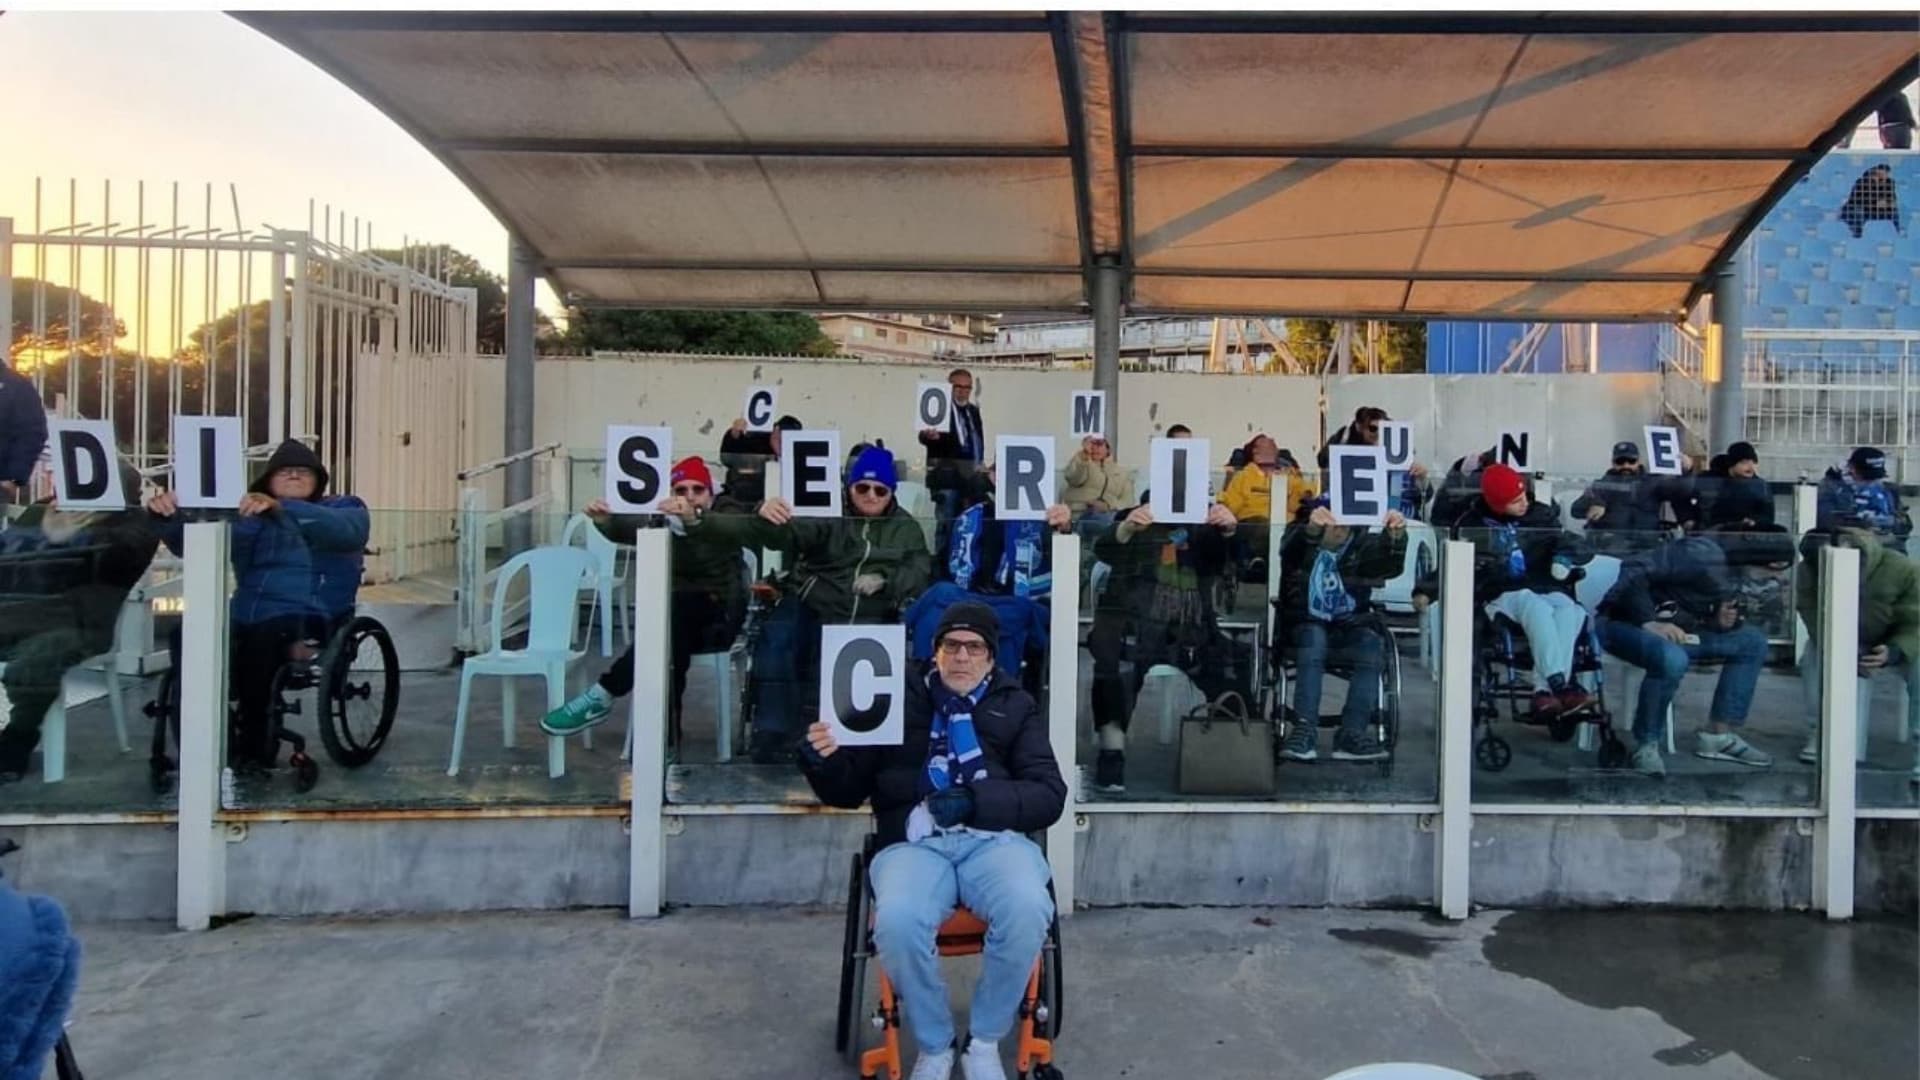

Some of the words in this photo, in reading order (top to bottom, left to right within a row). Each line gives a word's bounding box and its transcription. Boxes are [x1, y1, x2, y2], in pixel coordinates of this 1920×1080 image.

[749, 391, 772, 426] C
[920, 388, 946, 426] O
[1074, 396, 1100, 432] M
[60, 431, 108, 500] D
[200, 428, 216, 497] I
[617, 436, 659, 504] S
[793, 441, 830, 507] E
[1384, 427, 1408, 464] U
[1502, 433, 1528, 468] N
[1651, 432, 1675, 468] E
[1006, 446, 1046, 510] R
[1172, 449, 1187, 513] I
[1341, 455, 1378, 515] E
[833, 638, 892, 733] C
